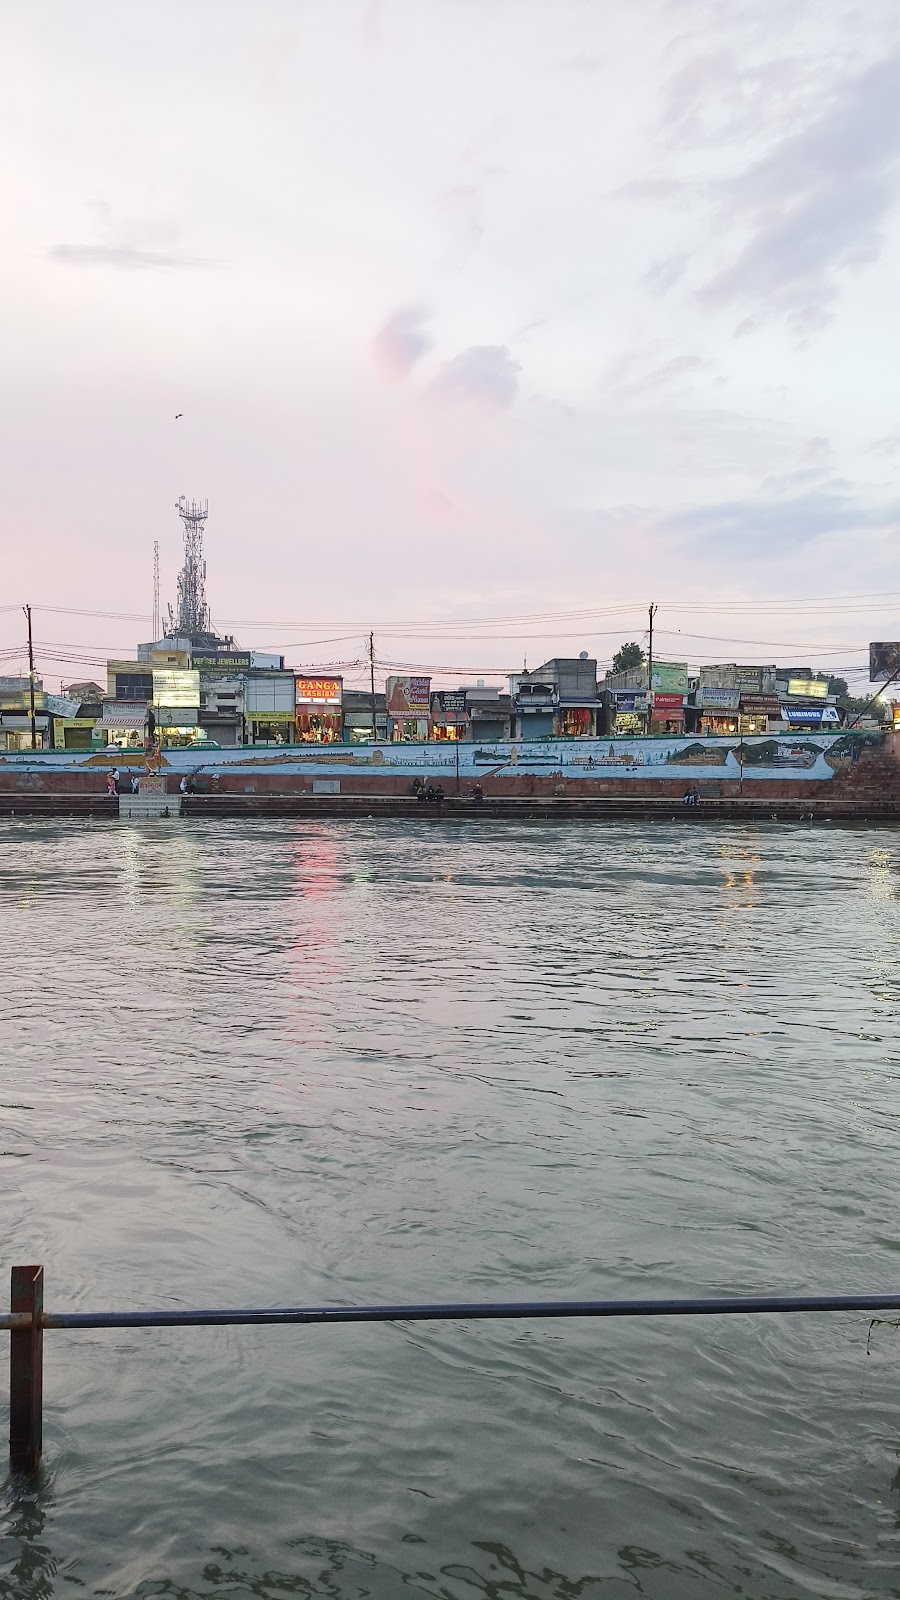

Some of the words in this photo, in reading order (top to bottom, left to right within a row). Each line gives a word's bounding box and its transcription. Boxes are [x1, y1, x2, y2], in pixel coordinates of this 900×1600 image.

[217, 658, 249, 666] JEWELLERS
[298, 680, 340, 690] GANGA
[302, 690, 335, 698] FASHION
